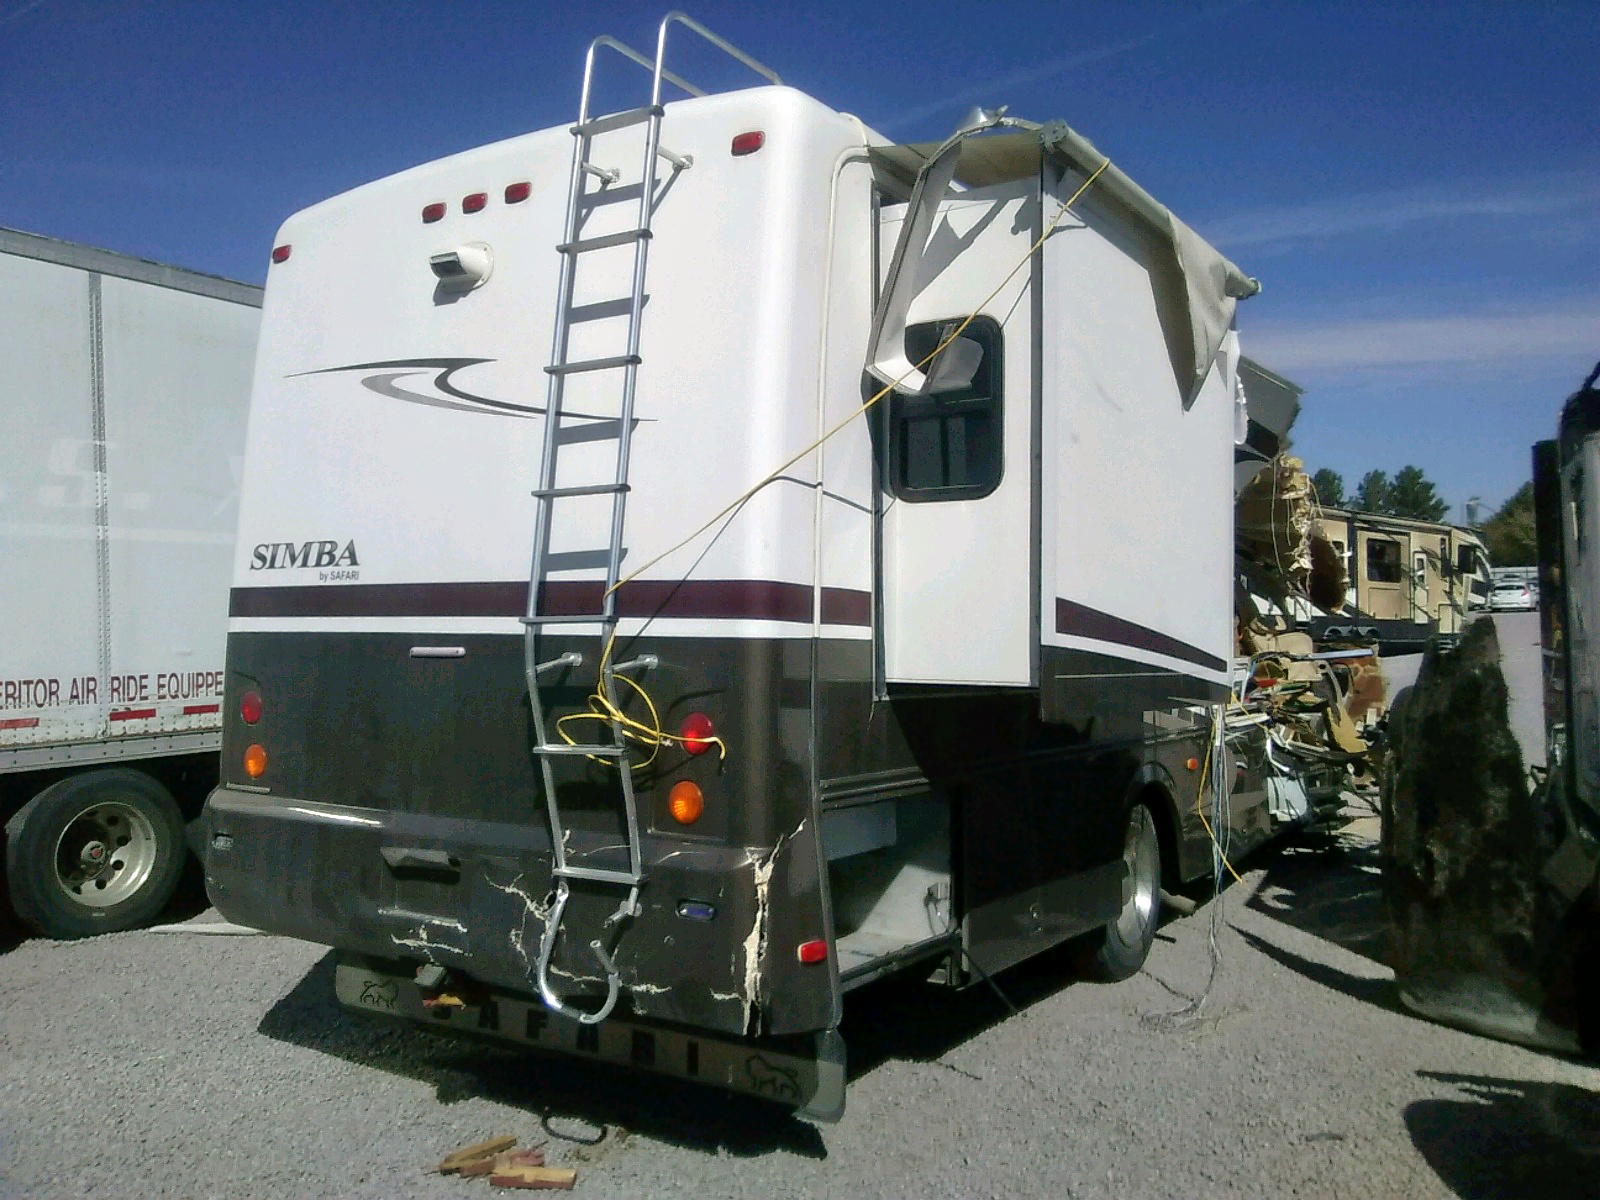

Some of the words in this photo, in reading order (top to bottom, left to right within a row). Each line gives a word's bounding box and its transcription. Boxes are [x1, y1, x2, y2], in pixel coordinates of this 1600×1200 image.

[249, 538, 360, 570] SIMBA
[320, 571, 329, 583] by
[330, 570, 360, 581] SAFARI
[69, 676, 97, 705] AIR
[111, 674, 149, 703] RIDE
[157, 671, 224, 700] EQUIPPE
